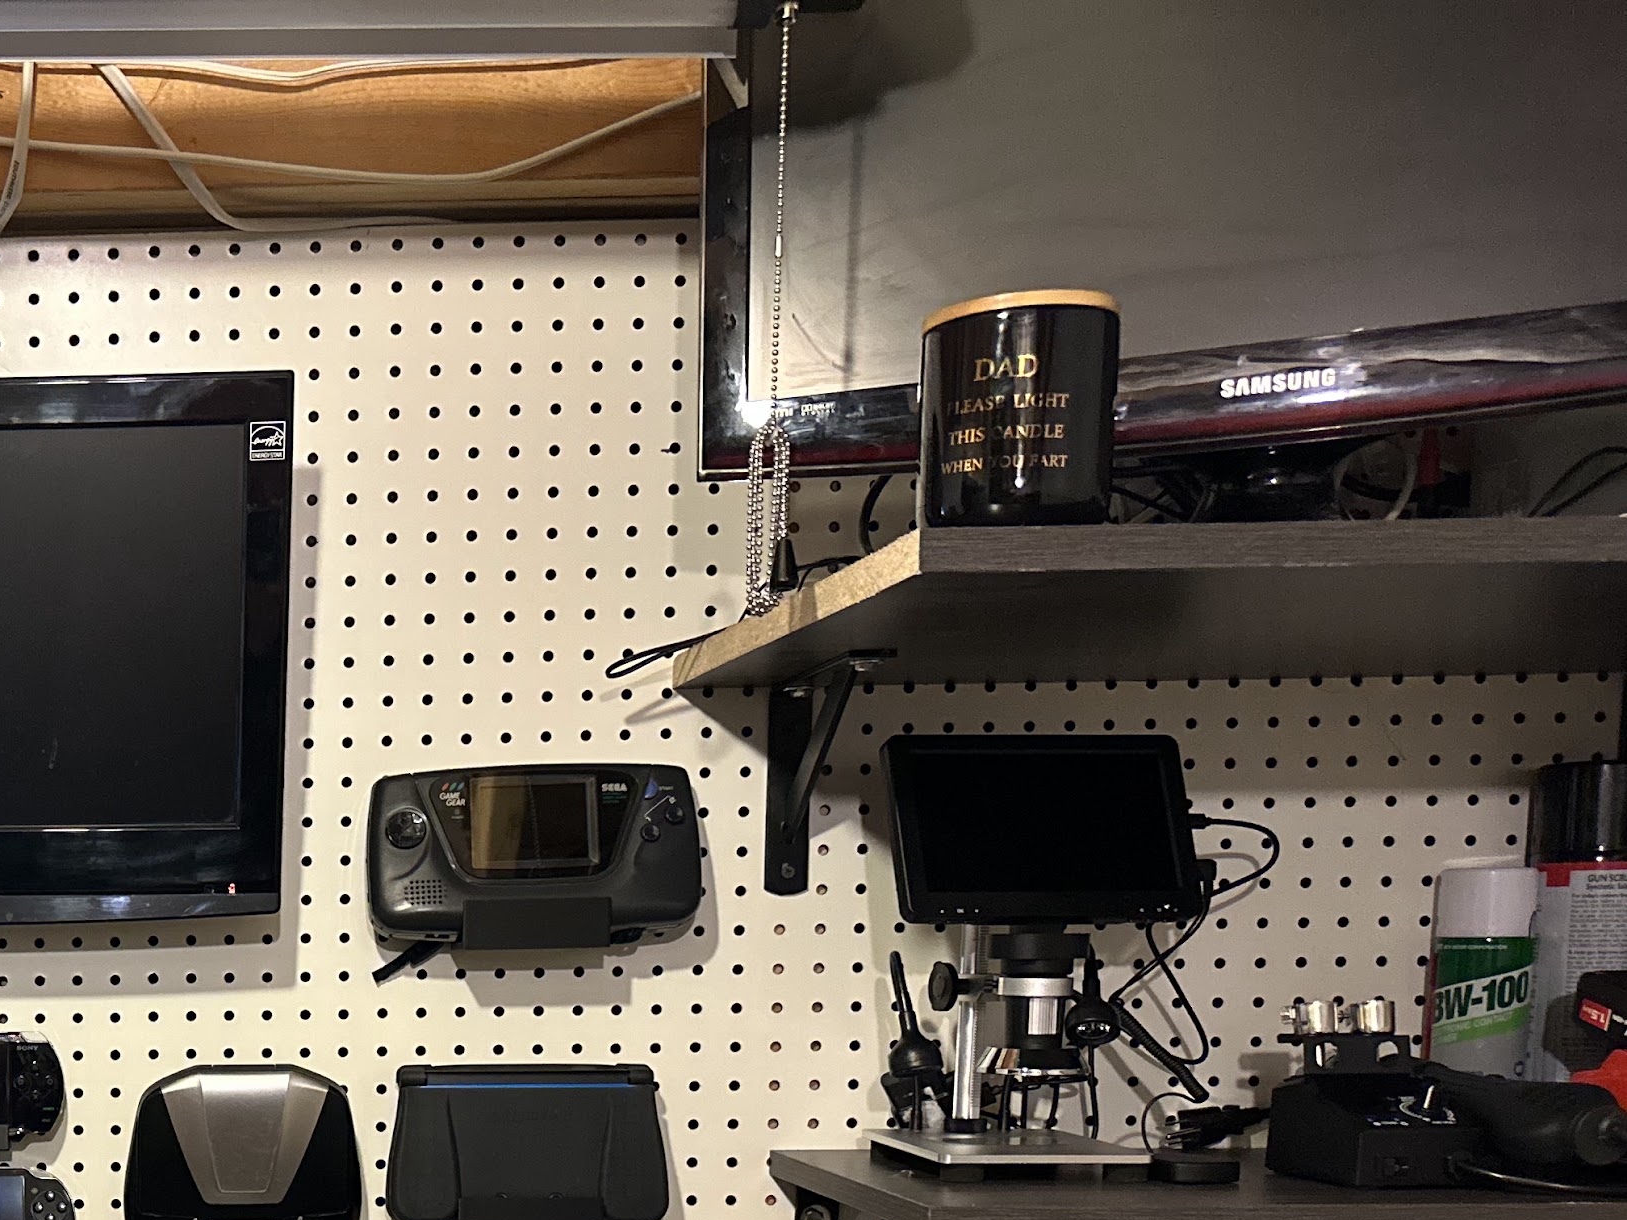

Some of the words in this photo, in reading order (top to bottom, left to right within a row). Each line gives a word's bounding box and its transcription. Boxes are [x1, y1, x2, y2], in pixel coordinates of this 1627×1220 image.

[973, 353, 1039, 382] DAD
[1219, 367, 1337, 398] SAMSUNG
[1013, 393, 1070, 409] LIGHT
[949, 427, 986, 446] THIS
[940, 457, 984, 475] WHEN
[1030, 454, 1069, 468] FART
[439, 792, 461, 800] GAME
[601, 783, 628, 792] SEGA
[445, 798, 466, 807] GEAR
